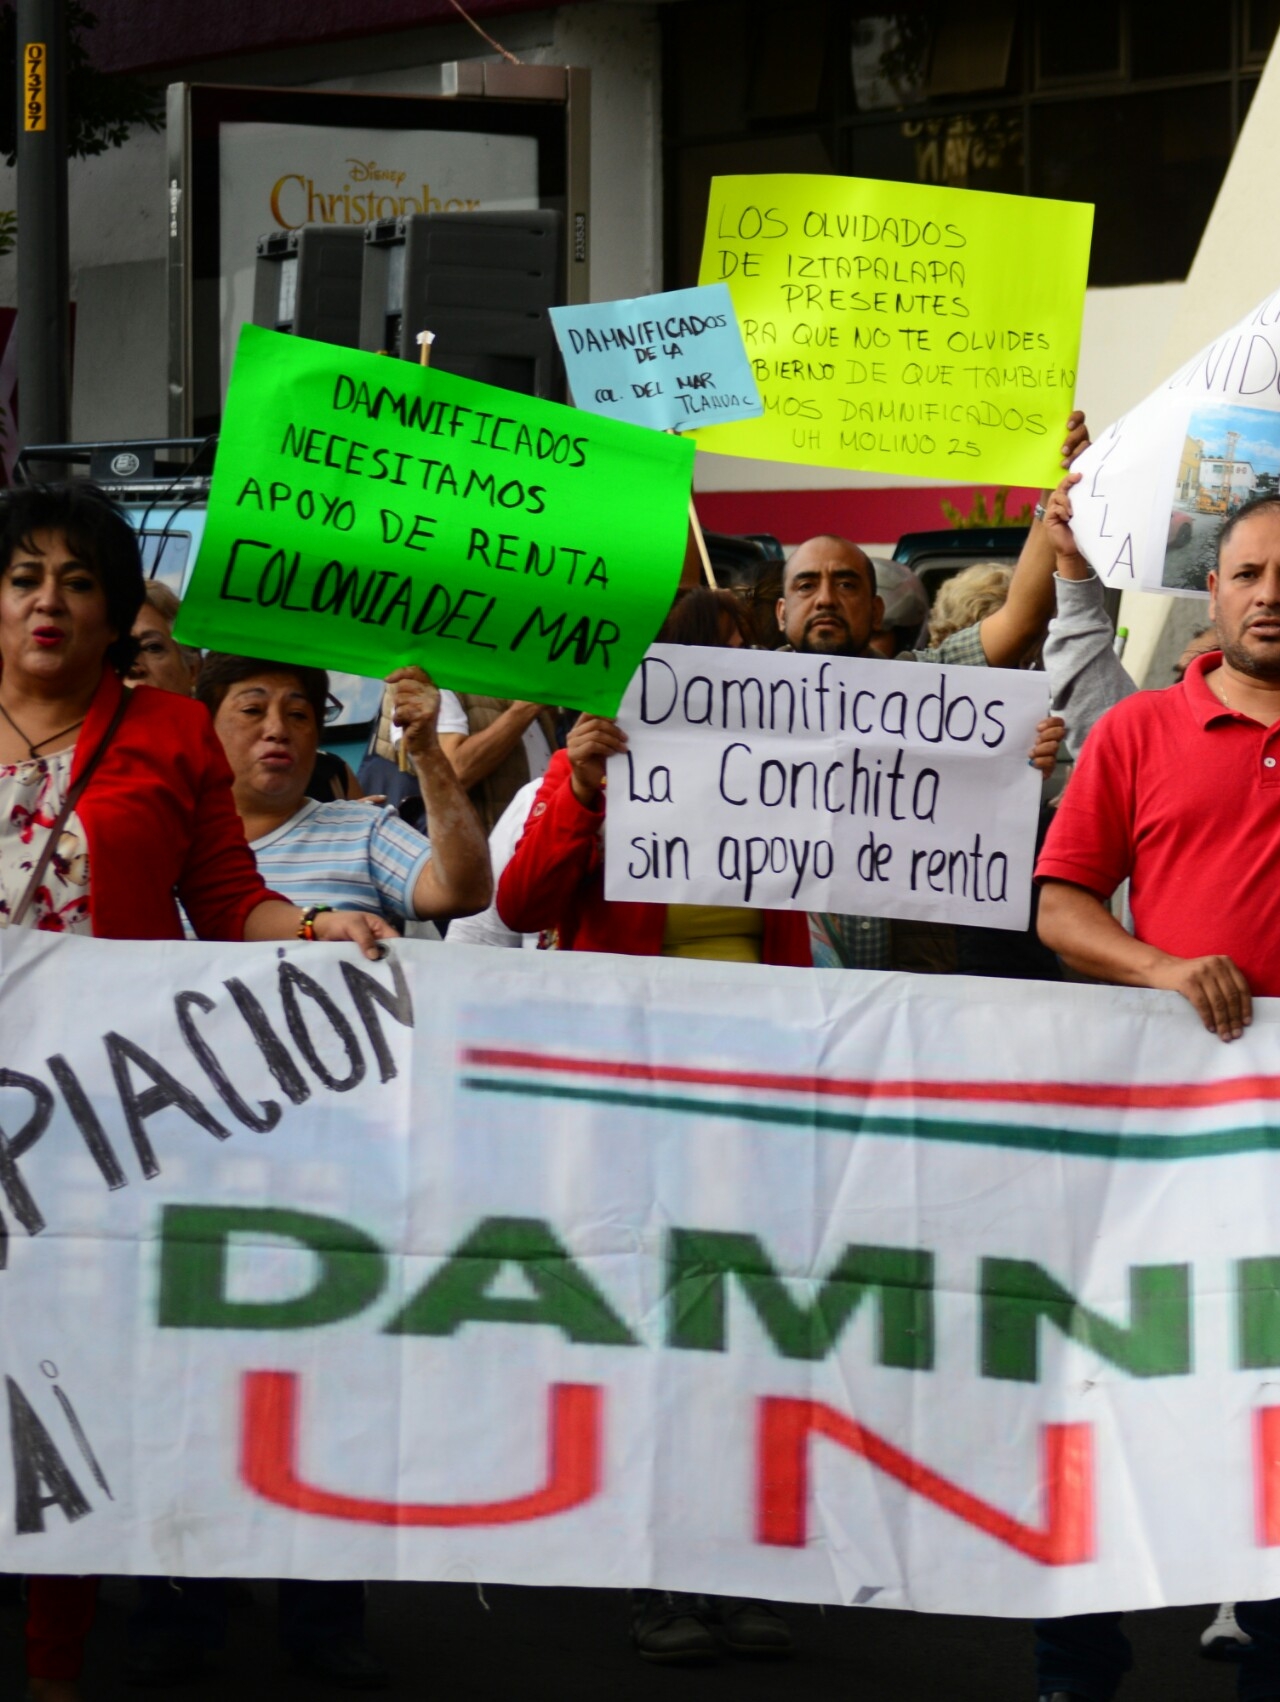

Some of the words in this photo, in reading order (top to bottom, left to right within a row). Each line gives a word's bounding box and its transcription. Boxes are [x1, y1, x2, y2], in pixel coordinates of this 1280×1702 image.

[28, 45, 42, 129] 073797
[718, 205, 788, 241] LOS
[803, 210, 967, 249] OLVIDADOS
[717, 251, 763, 281] DE
[787, 254, 966, 288] IZTAPALAPA
[781, 284, 970, 319] PRESENTES
[568, 314, 728, 354] DAMNIFICADOS
[634, 346, 658, 364] DE
[663, 342, 684, 359] LA
[743, 319, 776, 346] RA
[792, 322, 840, 348] QUE
[854, 326, 891, 351] NO
[899, 328, 931, 353] TE
[946, 329, 1051, 354] OLVIDES
[630, 381, 665, 400] DEL
[676, 372, 717, 391] MAR
[752, 358, 835, 382] BIERNO
[845, 360, 888, 386] DE
[902, 361, 954, 388] QUE
[962, 360, 1077, 391] TAMBIÉN
[332, 373, 590, 469] DAMNIFICADOS
[838, 396, 1049, 436] DAMNIFICADOS
[792, 428, 821, 451] UH
[839, 430, 936, 456] MOLINO
[947, 437, 982, 458] 25
[280, 422, 547, 516] NECESITAMOS
[236, 476, 358, 532] APOYO
[379, 507, 440, 553] DE
[466, 526, 611, 591] RENTA
[510, 605, 622, 670] MAR
[639, 656, 1007, 749] Damnificados
[626, 749, 675, 804] La
[719, 742, 940, 825] Conchita
[627, 831, 691, 881] sin
[718, 834, 835, 903] apoyo
[856, 830, 894, 883] de
[909, 832, 1009, 903] renta
